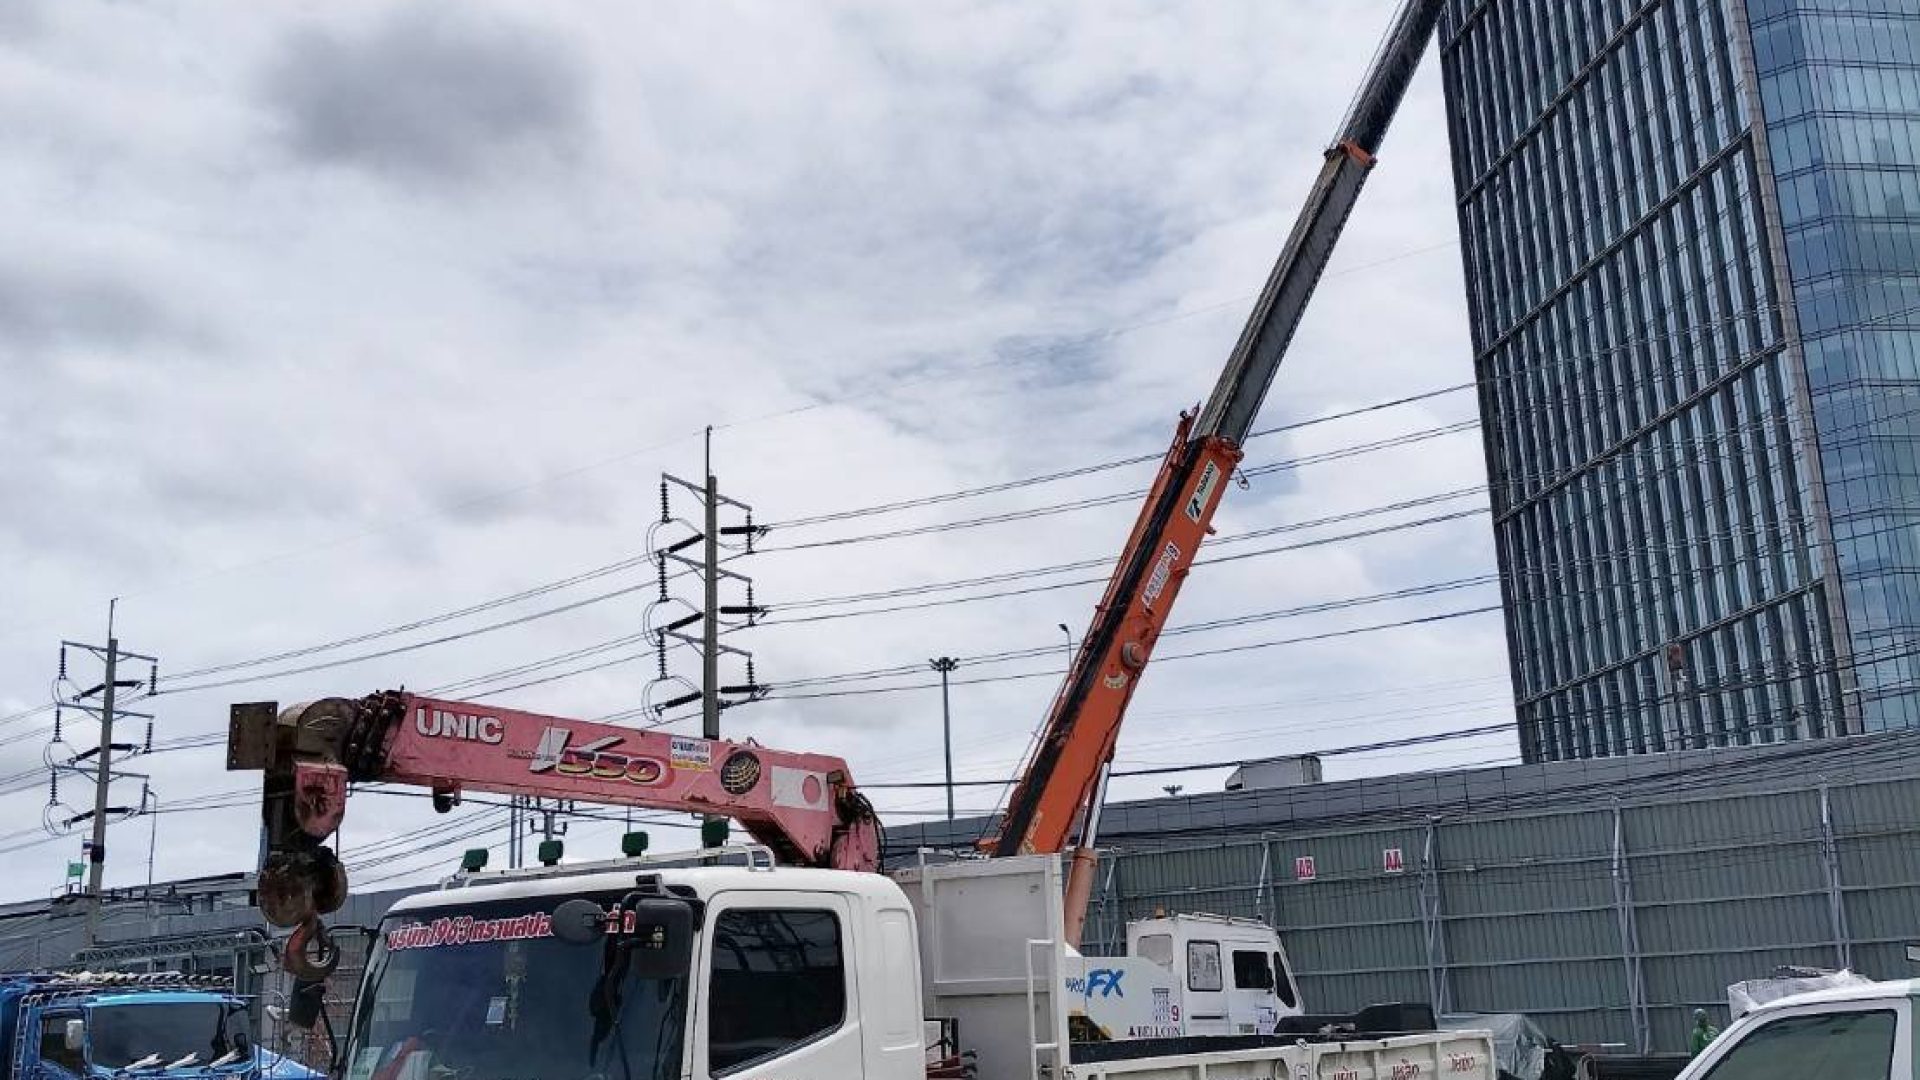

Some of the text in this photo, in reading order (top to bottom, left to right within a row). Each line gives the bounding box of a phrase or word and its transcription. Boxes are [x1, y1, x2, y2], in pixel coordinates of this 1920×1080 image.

[416, 707, 504, 744] UNIC
[1084, 968, 1124, 998] FX
[1170, 1004, 1180, 1022] 9
